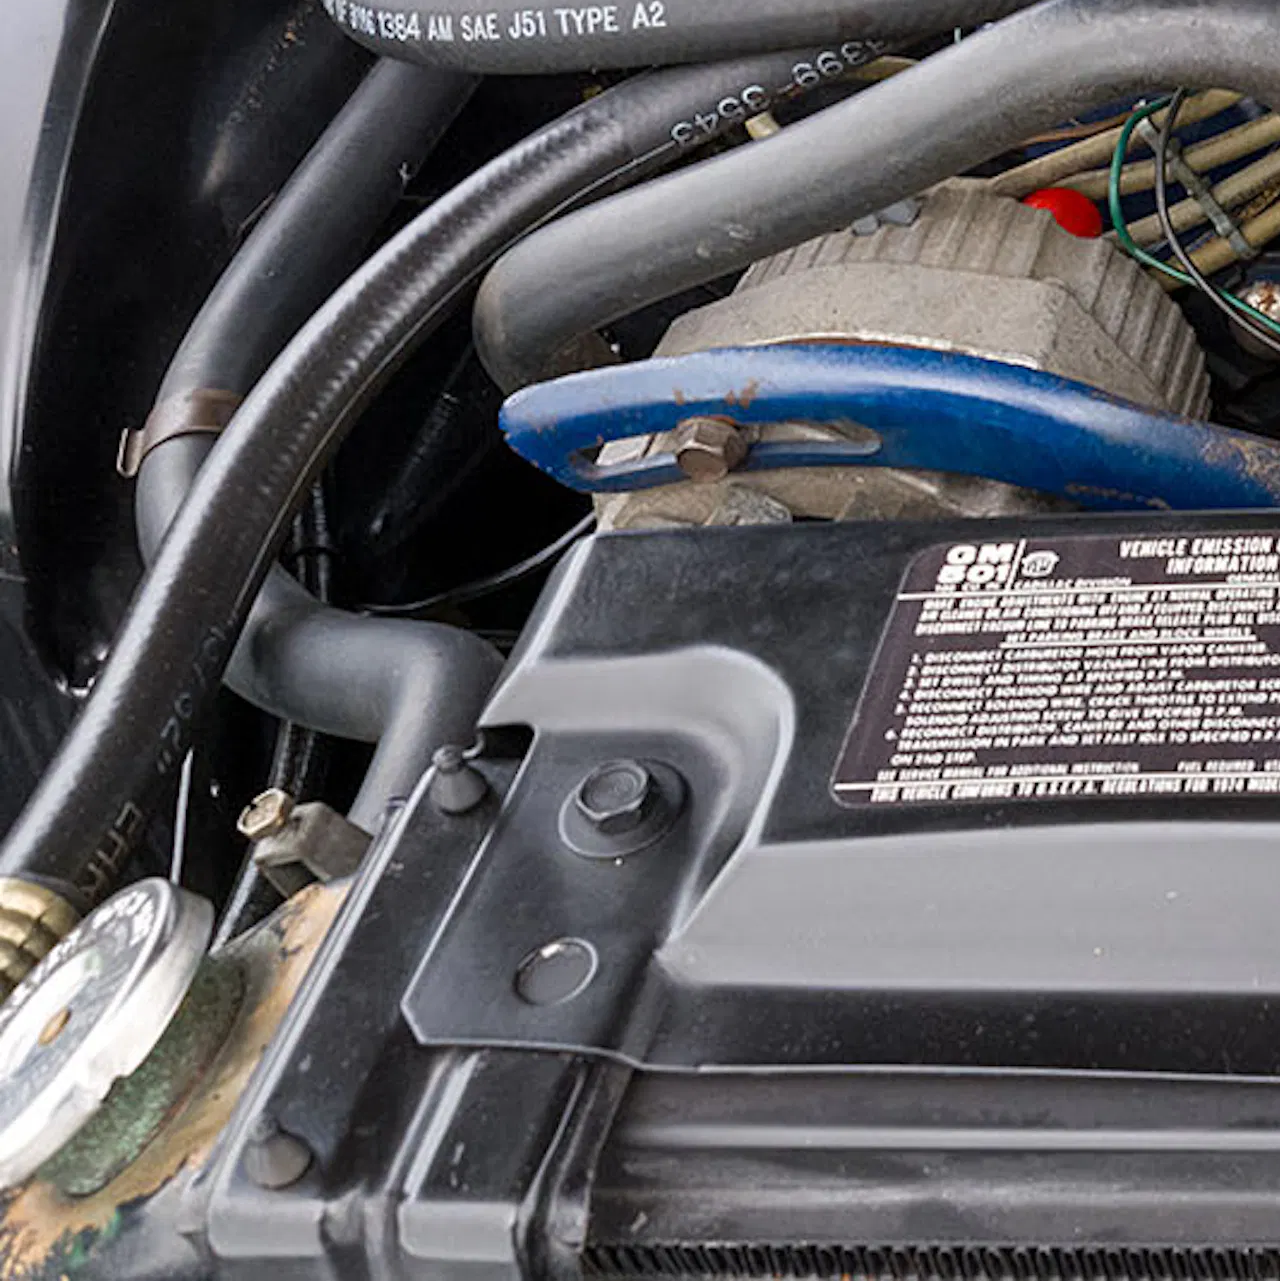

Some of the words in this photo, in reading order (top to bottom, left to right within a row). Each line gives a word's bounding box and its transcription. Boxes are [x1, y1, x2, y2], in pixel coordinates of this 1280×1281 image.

[461, 16, 500, 41] SAE
[508, 10, 546, 40] J51
[554, 5, 620, 37] TYPE
[632, 0, 667, 29] A2
[1115, 538, 1187, 560] VEHICLE
[1189, 535, 1273, 557] EMISSION
[1164, 554, 1280, 574] INFORMATION
[899, 785, 950, 801] VEHICLE
